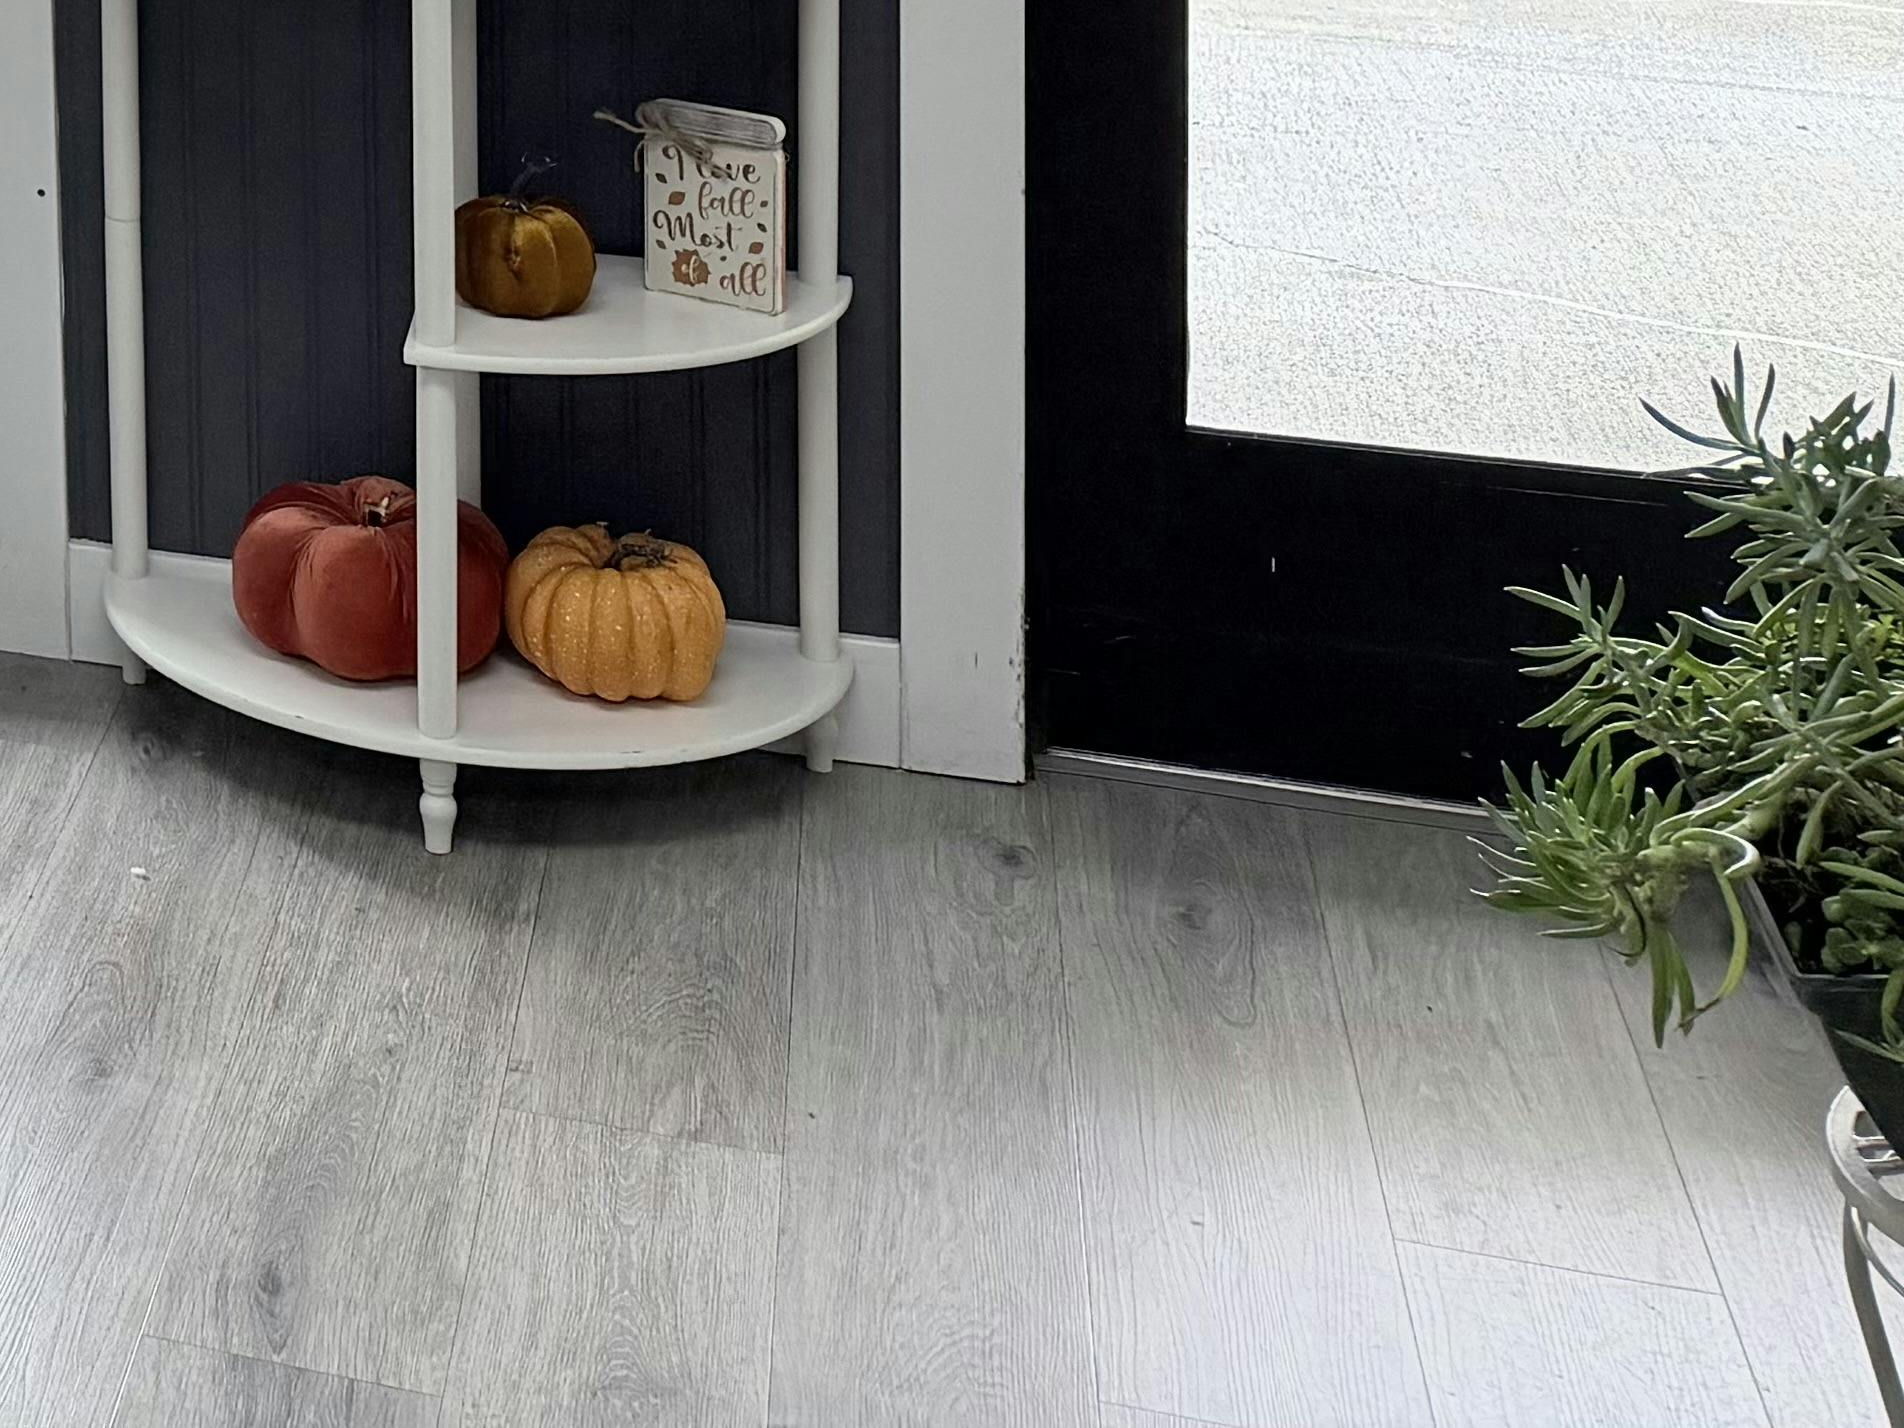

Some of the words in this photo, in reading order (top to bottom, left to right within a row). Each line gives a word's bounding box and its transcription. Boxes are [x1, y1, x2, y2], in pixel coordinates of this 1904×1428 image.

[697, 181, 756, 220] fall
[653, 210, 744, 252] Most
[719, 261, 768, 297] all
